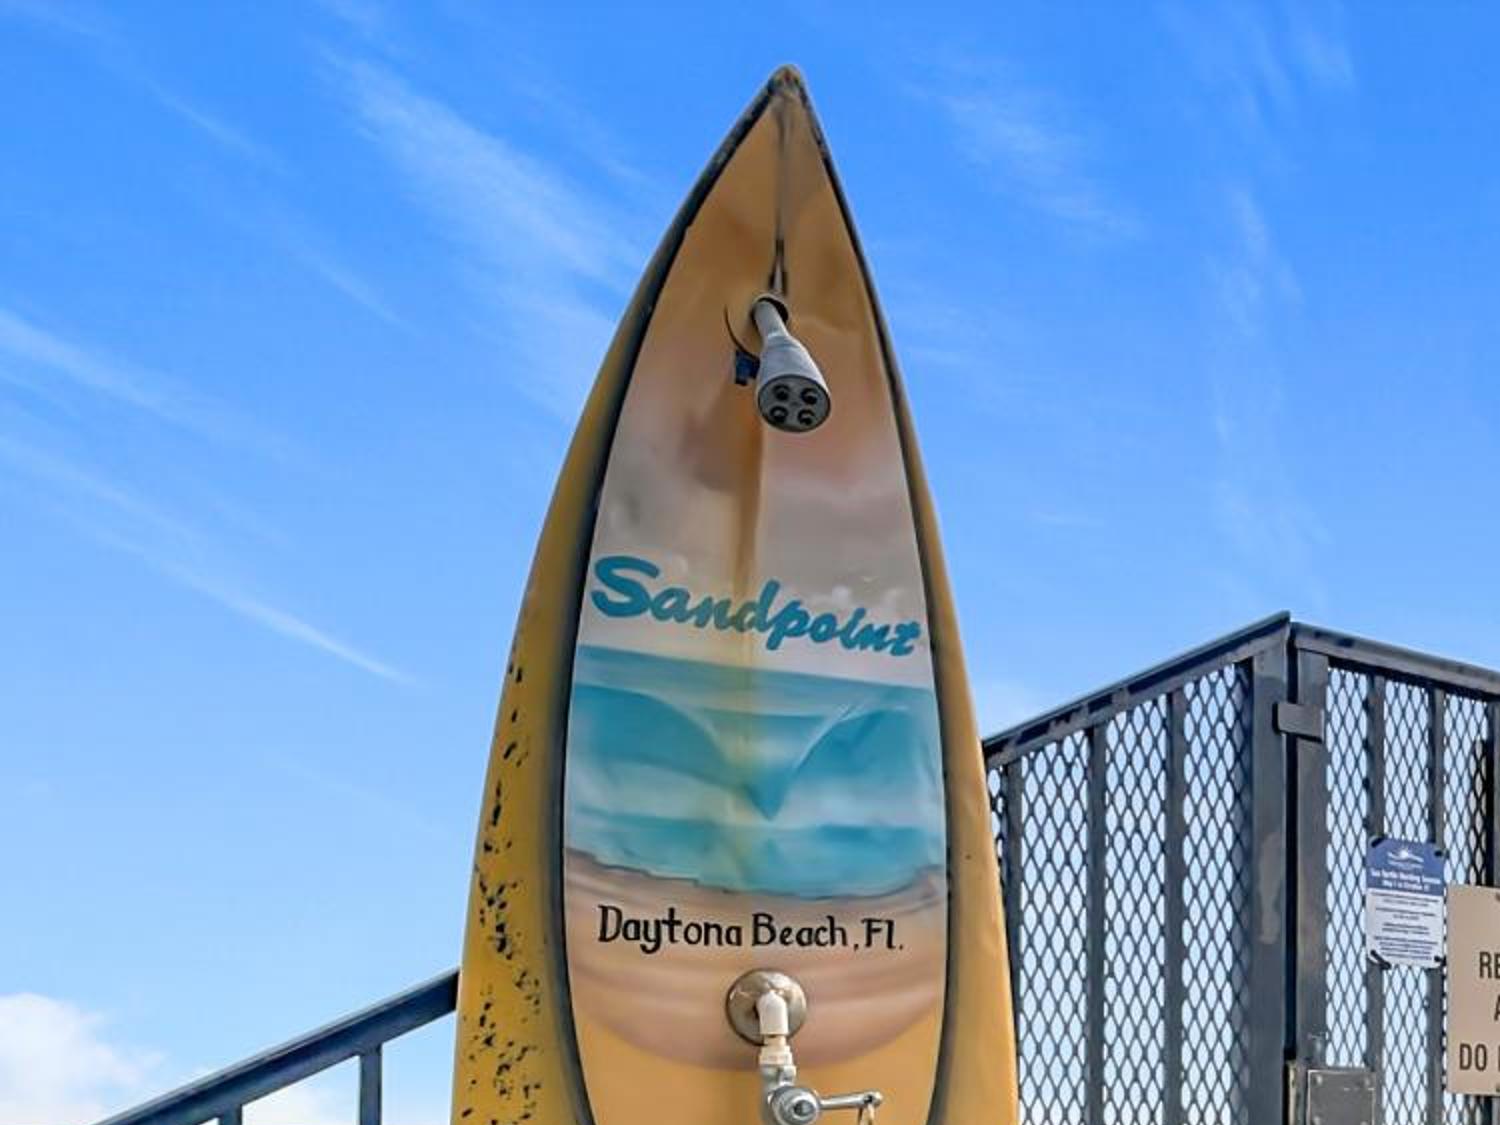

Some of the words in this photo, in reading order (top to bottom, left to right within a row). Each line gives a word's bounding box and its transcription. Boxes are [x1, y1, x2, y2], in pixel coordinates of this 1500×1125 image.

[590, 555, 922, 657] Sandpoint
[598, 904, 742, 955] Daytona
[1459, 1043, 1488, 1072] DO
